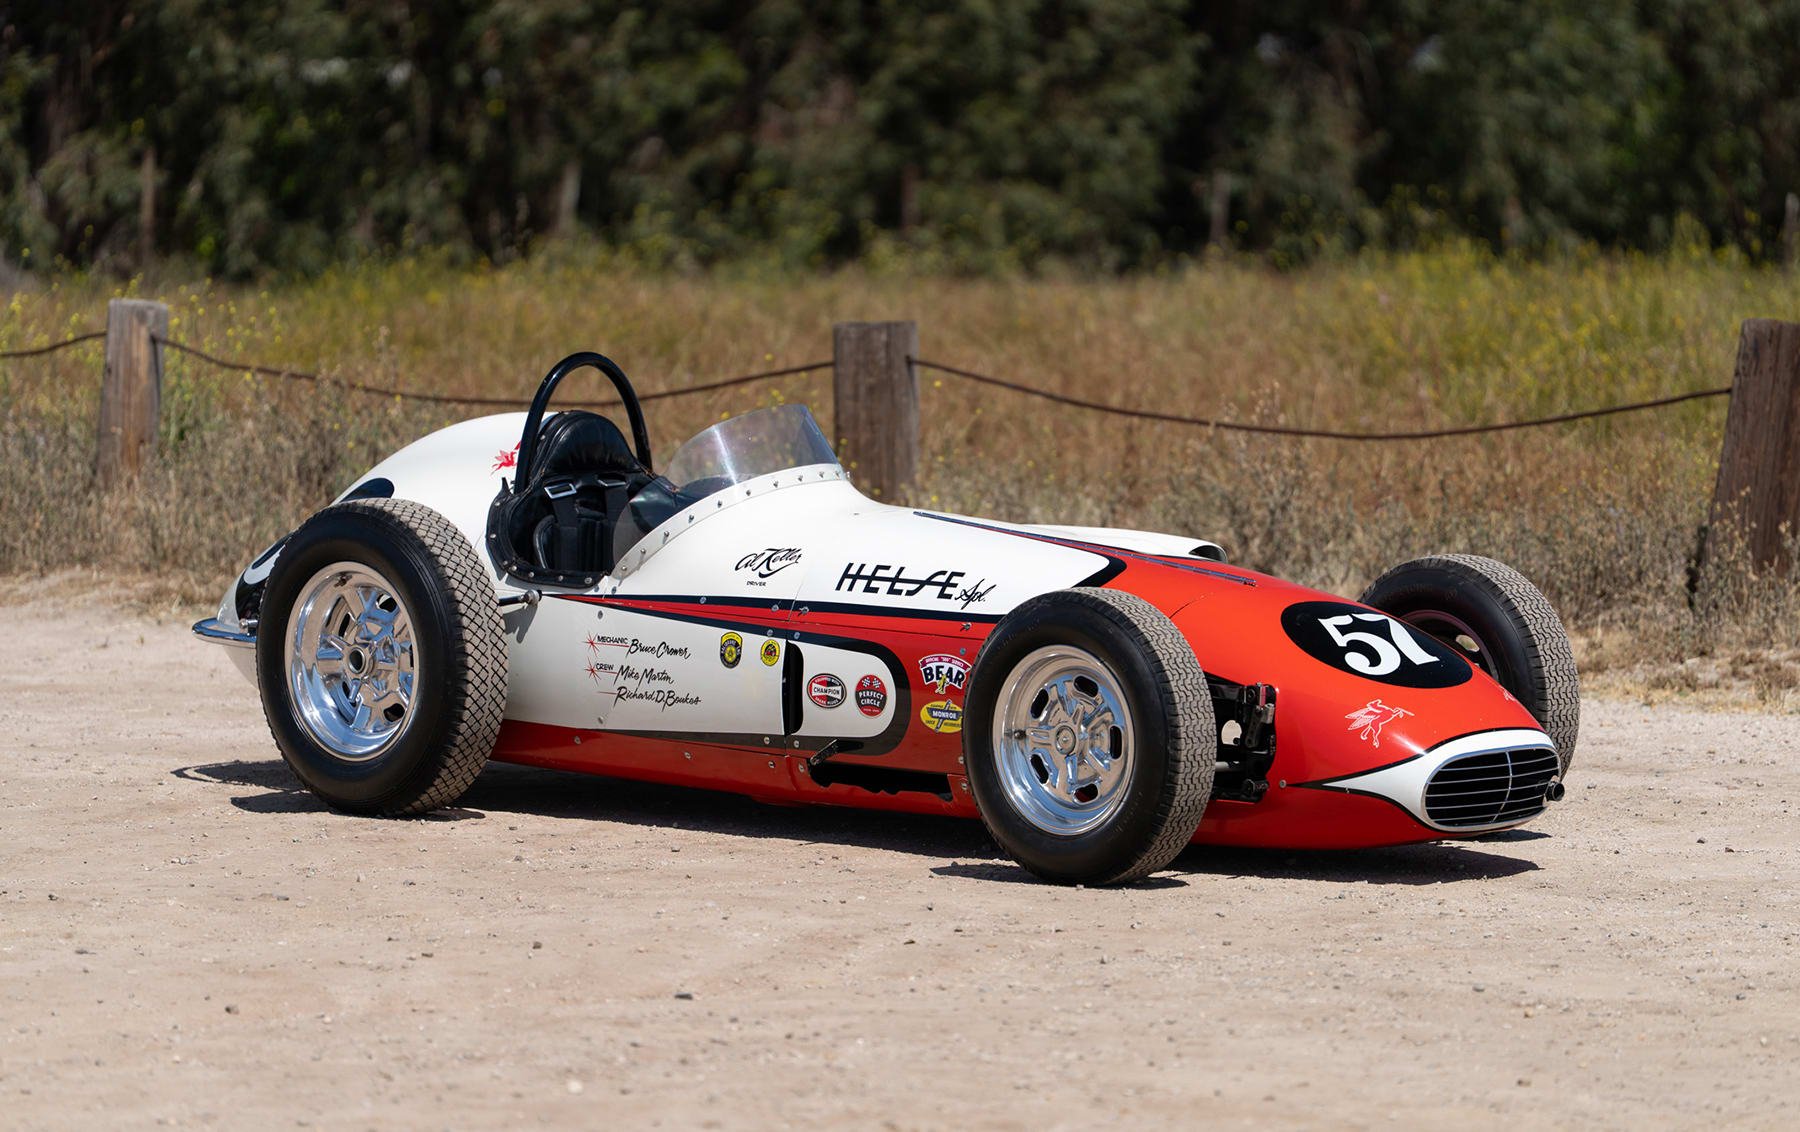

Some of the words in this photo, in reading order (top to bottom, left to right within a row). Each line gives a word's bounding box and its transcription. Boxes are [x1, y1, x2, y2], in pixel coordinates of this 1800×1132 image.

[835, 562, 966, 600] HELSE
[597, 635, 628, 644] MECHANIC
[625, 638, 657, 659] Bruce
[655, 641, 691, 659] Crower
[1317, 613, 1440, 676] 57
[595, 662, 614, 671] CREW
[613, 665, 640, 687] Mike
[922, 665, 965, 689] BEAR
[613, 685, 656, 709] Richard
[813, 686, 840, 696] CHAMPION
[858, 689, 884, 700] PERFECT
[860, 698, 881, 707] CIRCLE
[932, 710, 957, 720] MONROE
